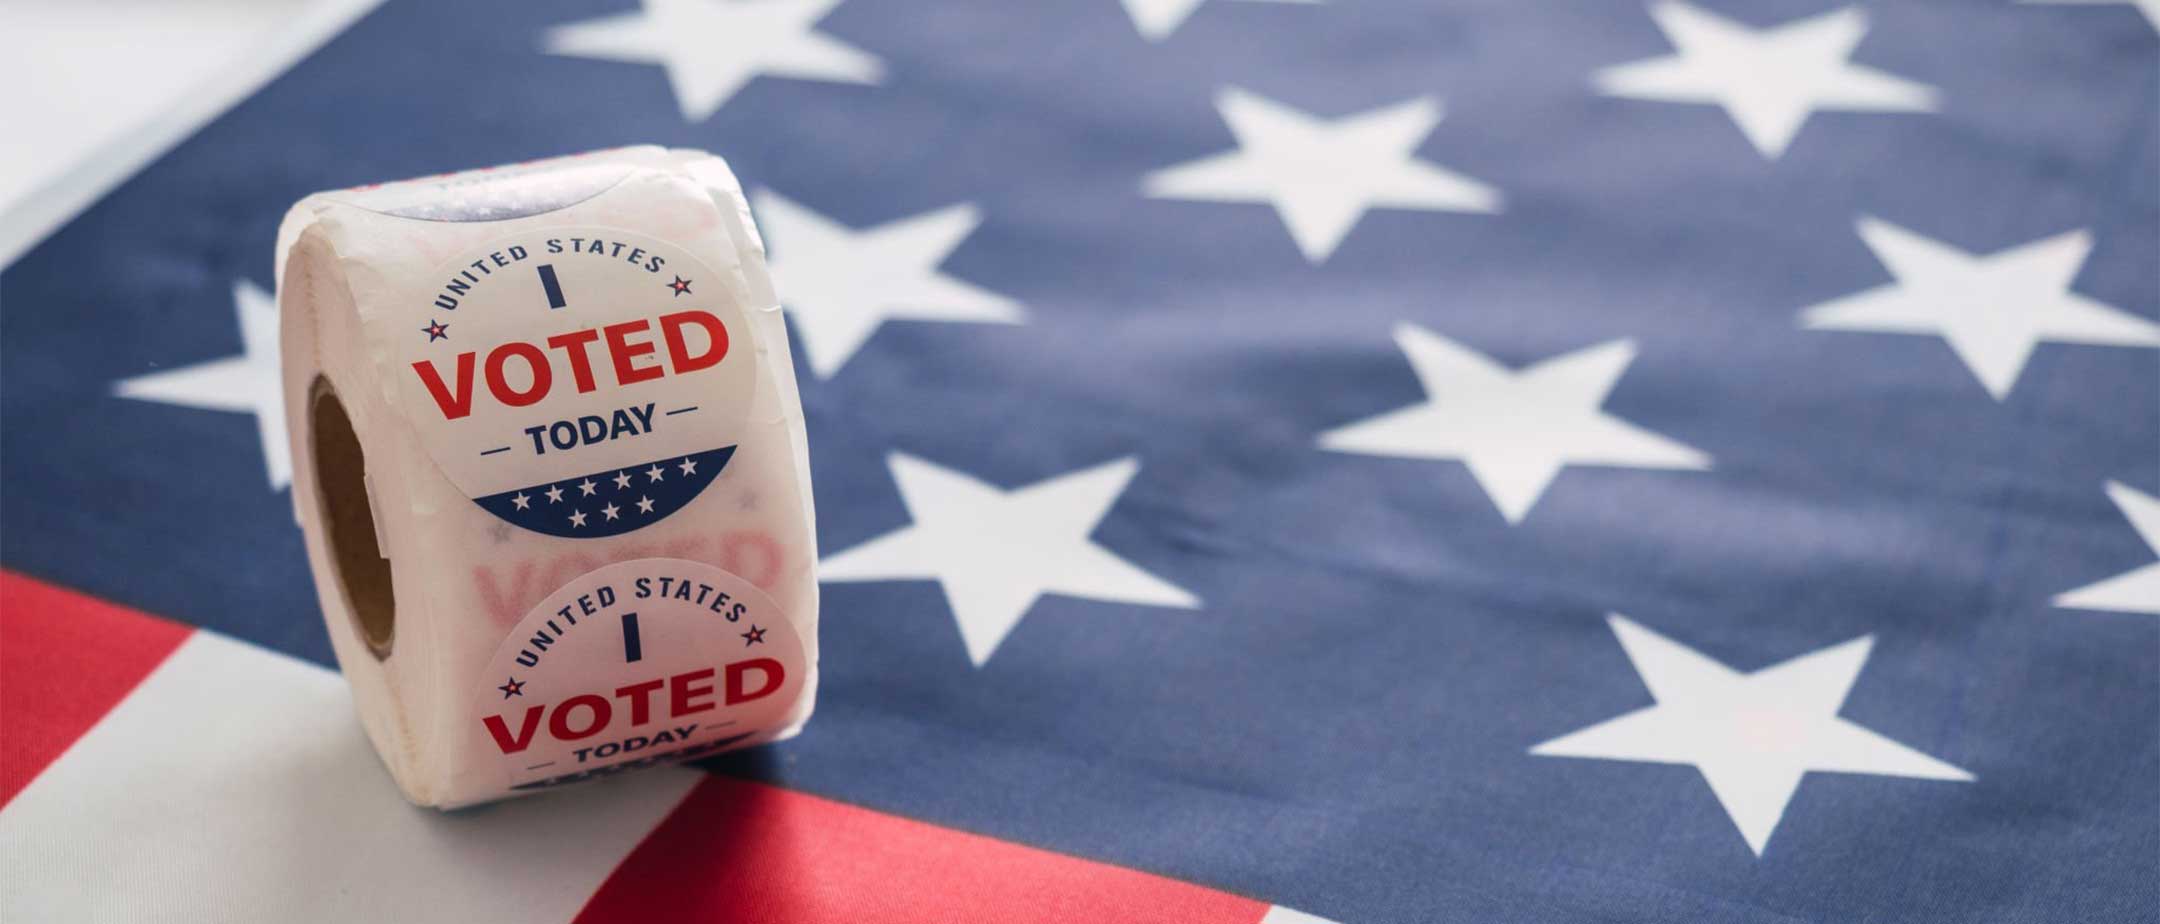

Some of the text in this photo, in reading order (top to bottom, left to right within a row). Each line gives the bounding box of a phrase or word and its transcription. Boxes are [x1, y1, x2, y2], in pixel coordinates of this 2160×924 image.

[435, 238, 666, 311] UNITED STATES
[536, 263, 567, 309] I
[411, 310, 730, 420] VOTED
[525, 402, 656, 455] TODAY
[516, 577, 747, 668] UNITED STATES
[621, 612, 642, 663] I
[482, 657, 786, 755] VOTED
[572, 724, 699, 763] TODAY
